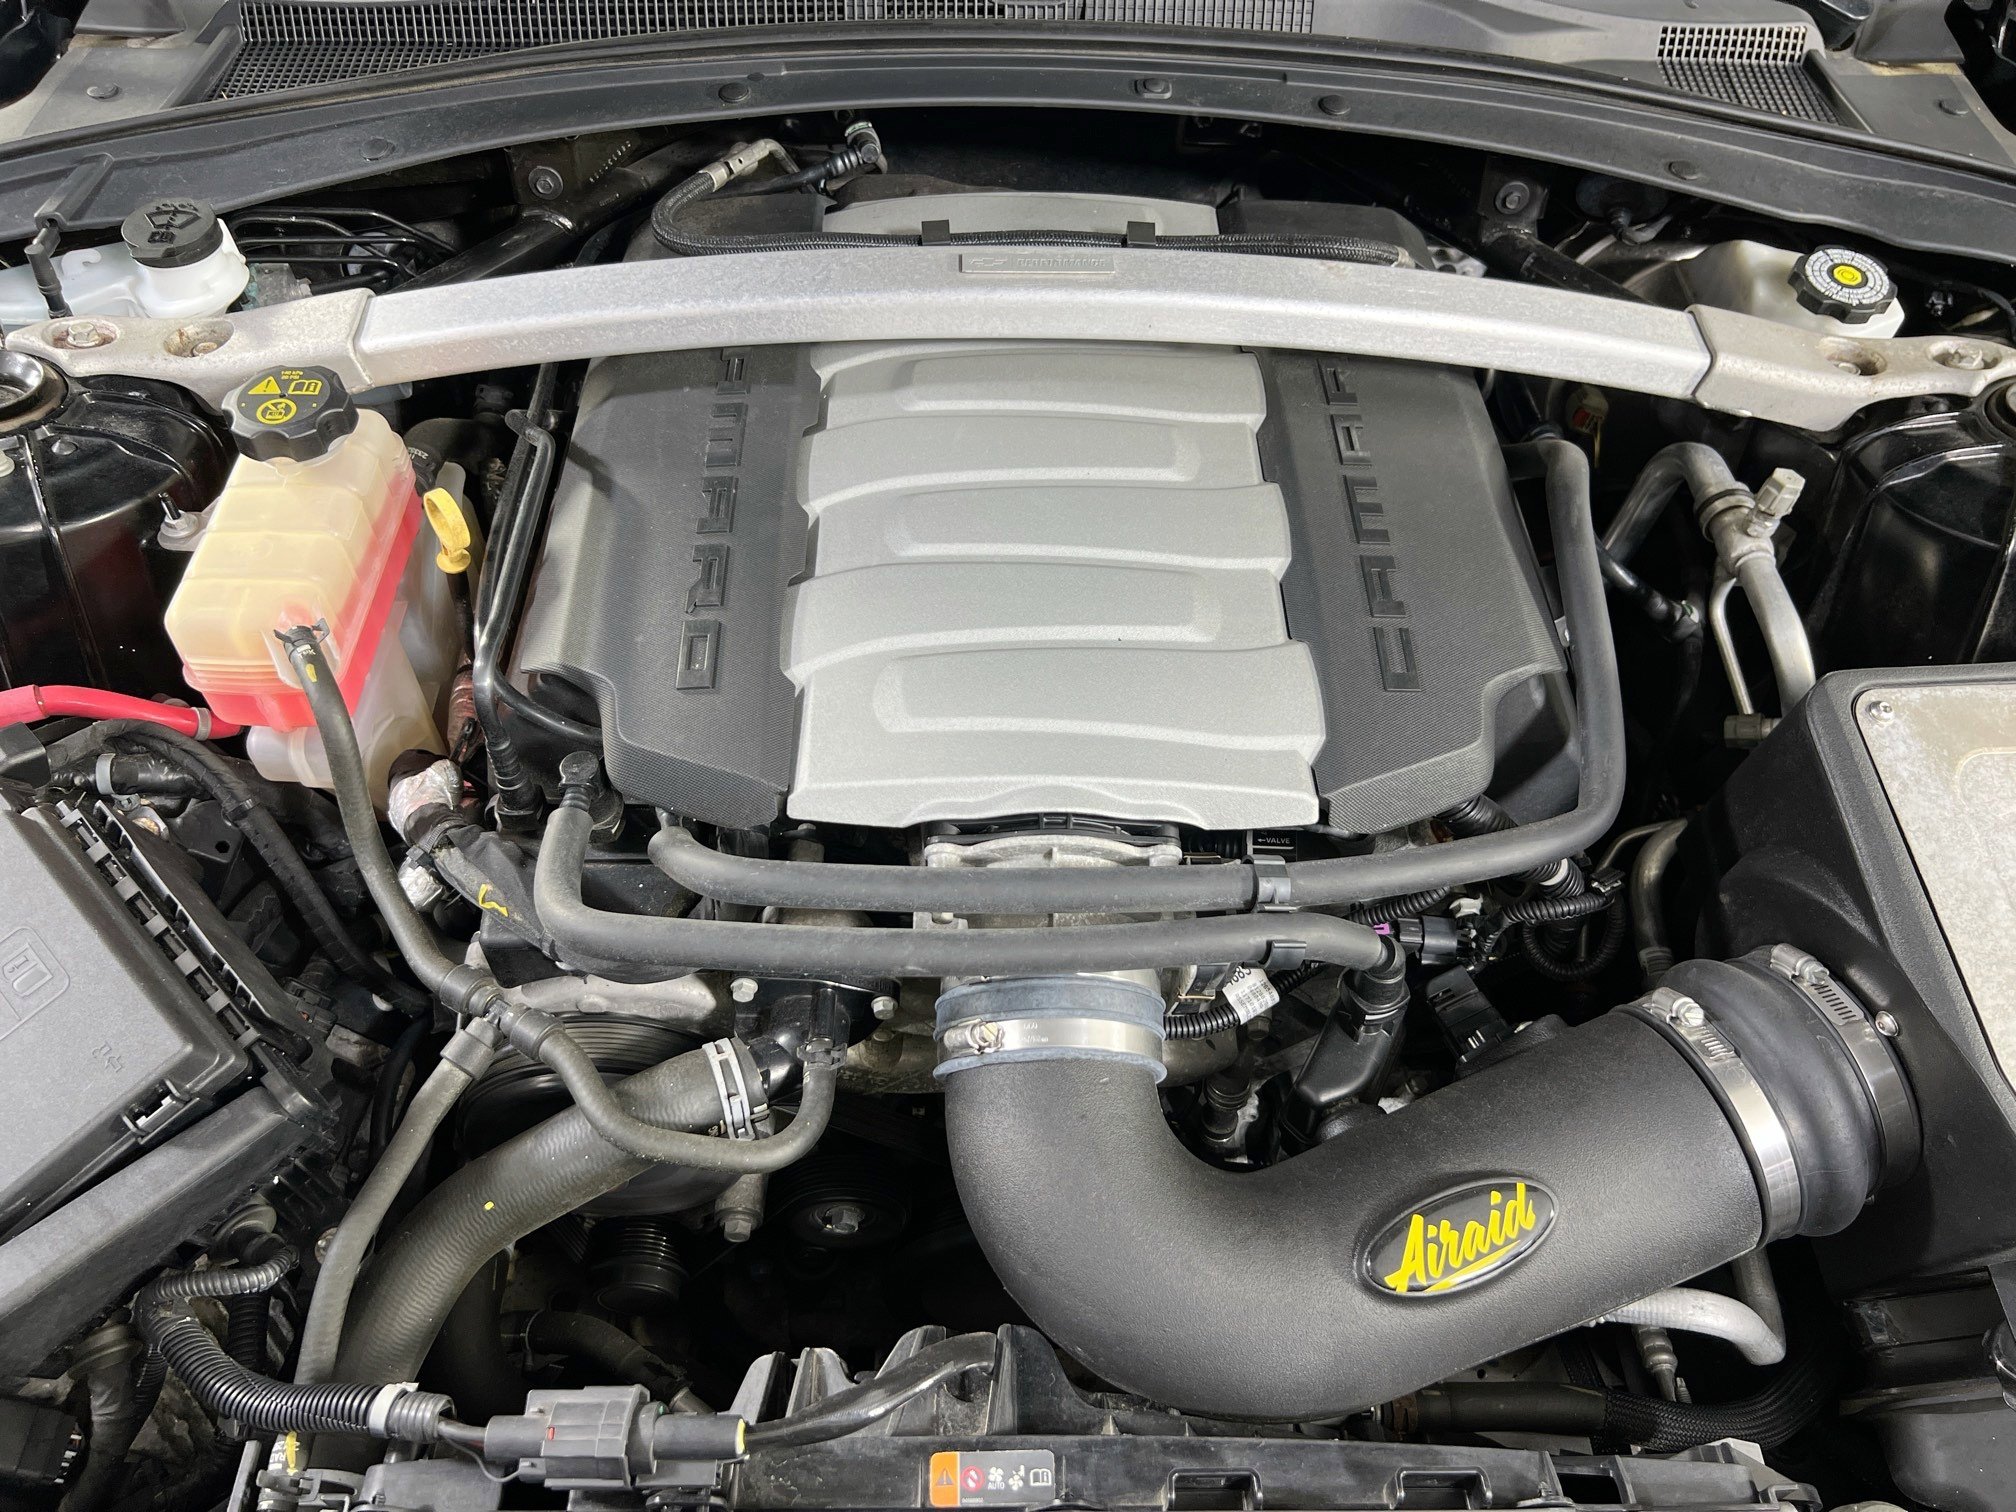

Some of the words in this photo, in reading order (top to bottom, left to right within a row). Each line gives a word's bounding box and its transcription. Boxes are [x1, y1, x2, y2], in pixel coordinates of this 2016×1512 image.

[676, 348, 751, 690] AMARO
[1317, 357, 1422, 692] CAMAR
[1383, 1182, 1537, 1293] Airaid
[987, 1482, 1005, 1490] AUTO
